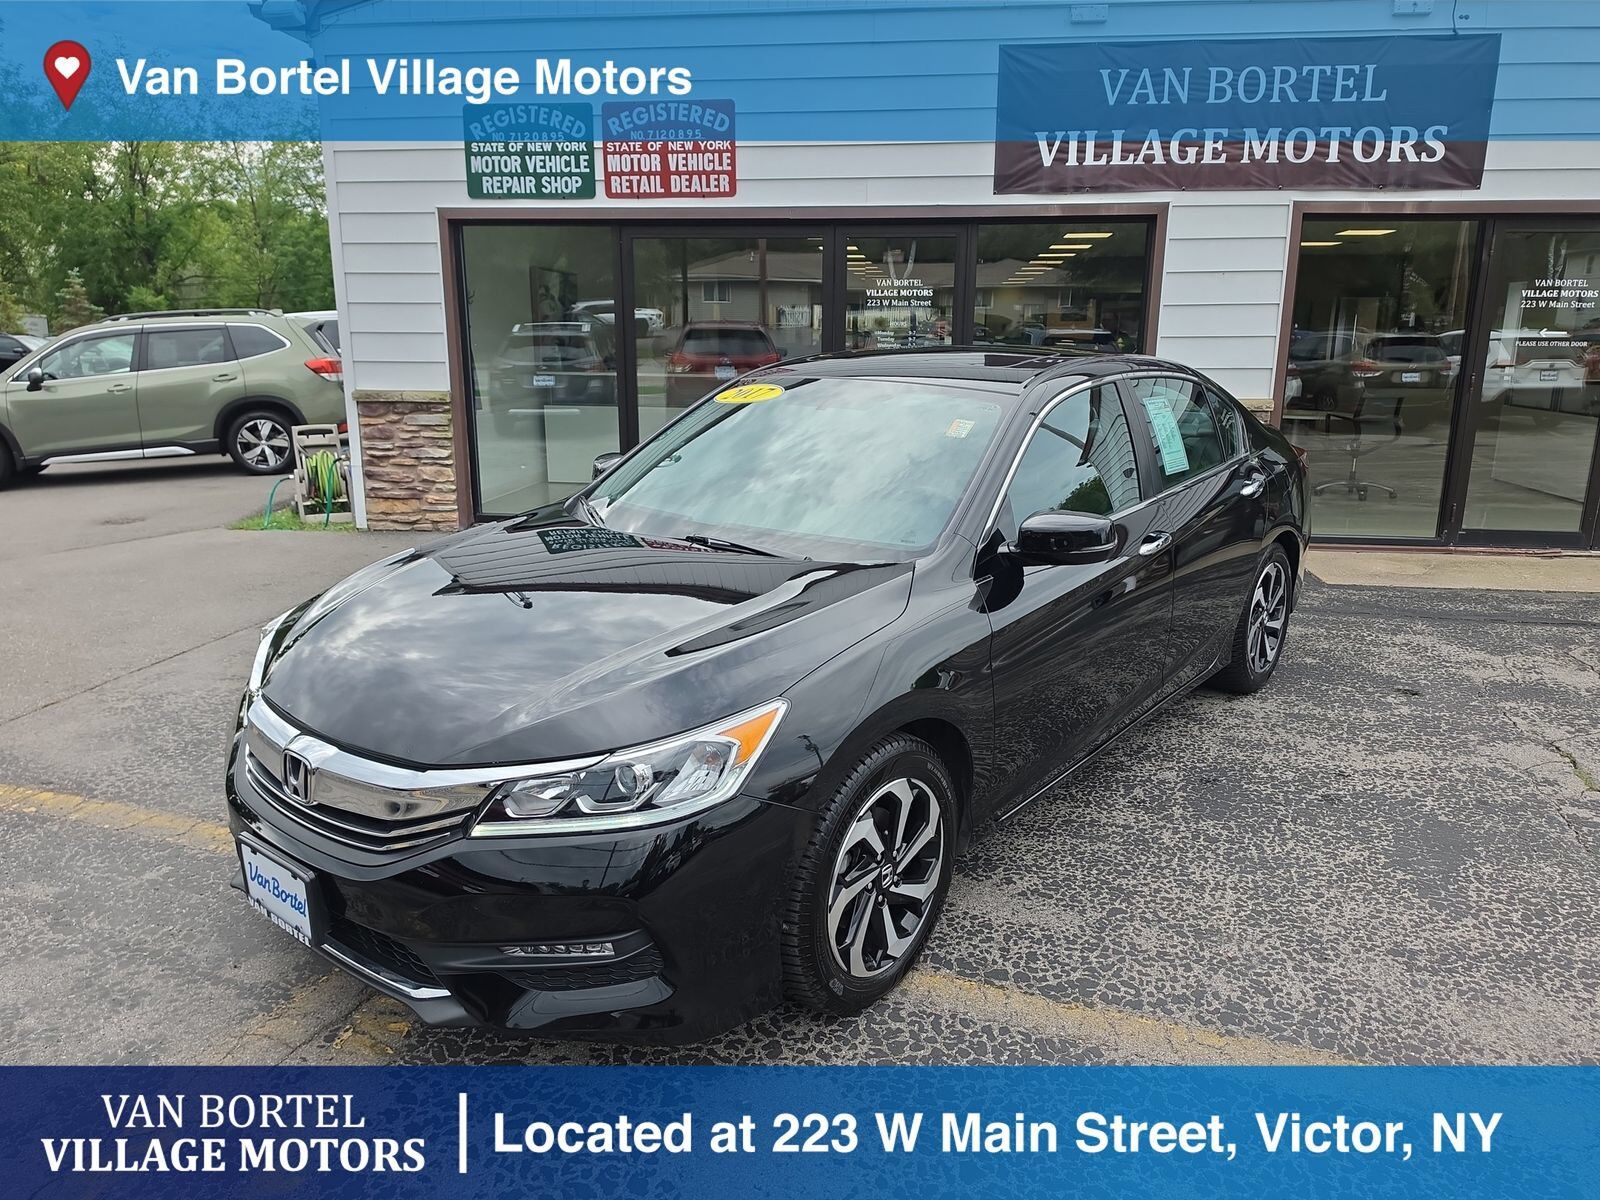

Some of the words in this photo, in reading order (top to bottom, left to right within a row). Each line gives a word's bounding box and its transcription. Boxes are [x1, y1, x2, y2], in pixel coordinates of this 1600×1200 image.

[1101, 67, 1193, 105] VAN
[1207, 64, 1388, 103] BORTEL
[470, 105, 586, 140] REGISTERED
[607, 103, 730, 136] REGISTERED
[509, 132, 565, 141] 7120895
[648, 129, 702, 139] 7120895
[471, 142, 505, 152] STATE
[508, 142, 524, 152] OF
[527, 142, 552, 152] NEW
[556, 142, 587, 152] YORK
[607, 142, 642, 152] STATE
[648, 142, 663, 151] OF
[668, 141, 693, 150] NEW
[698, 141, 731, 150] YORK
[1036, 128, 1230, 167] VILLAGE
[1241, 125, 1448, 165] MOTORS
[470, 155, 521, 173] MOTOR
[525, 155, 590, 173] VEHICLE
[607, 153, 661, 172] MOTOR
[668, 153, 731, 171] VEHICLE
[482, 176, 536, 194] REPAIR
[541, 176, 582, 194] SHOP
[611, 175, 665, 193] RETAIL
[670, 174, 730, 193] DEALER
[1535, 279, 1553, 287] VAN
[1554, 279, 1589, 287] BORTEL
[866, 289, 898, 297] VILLAGE
[900, 289, 933, 297] MOTORS
[1521, 290, 1559, 298] VILLAGE
[1560, 289, 1599, 298] MOTORS
[1520, 300, 1537, 308] 223
[1538, 300, 1548, 308] W
[1549, 300, 1569, 308] Main
[1570, 300, 1595, 308] Street
[248, 862, 271, 893] Van
[271, 877, 307, 918] Bortel
[271, 914, 312, 948] BORTEL
